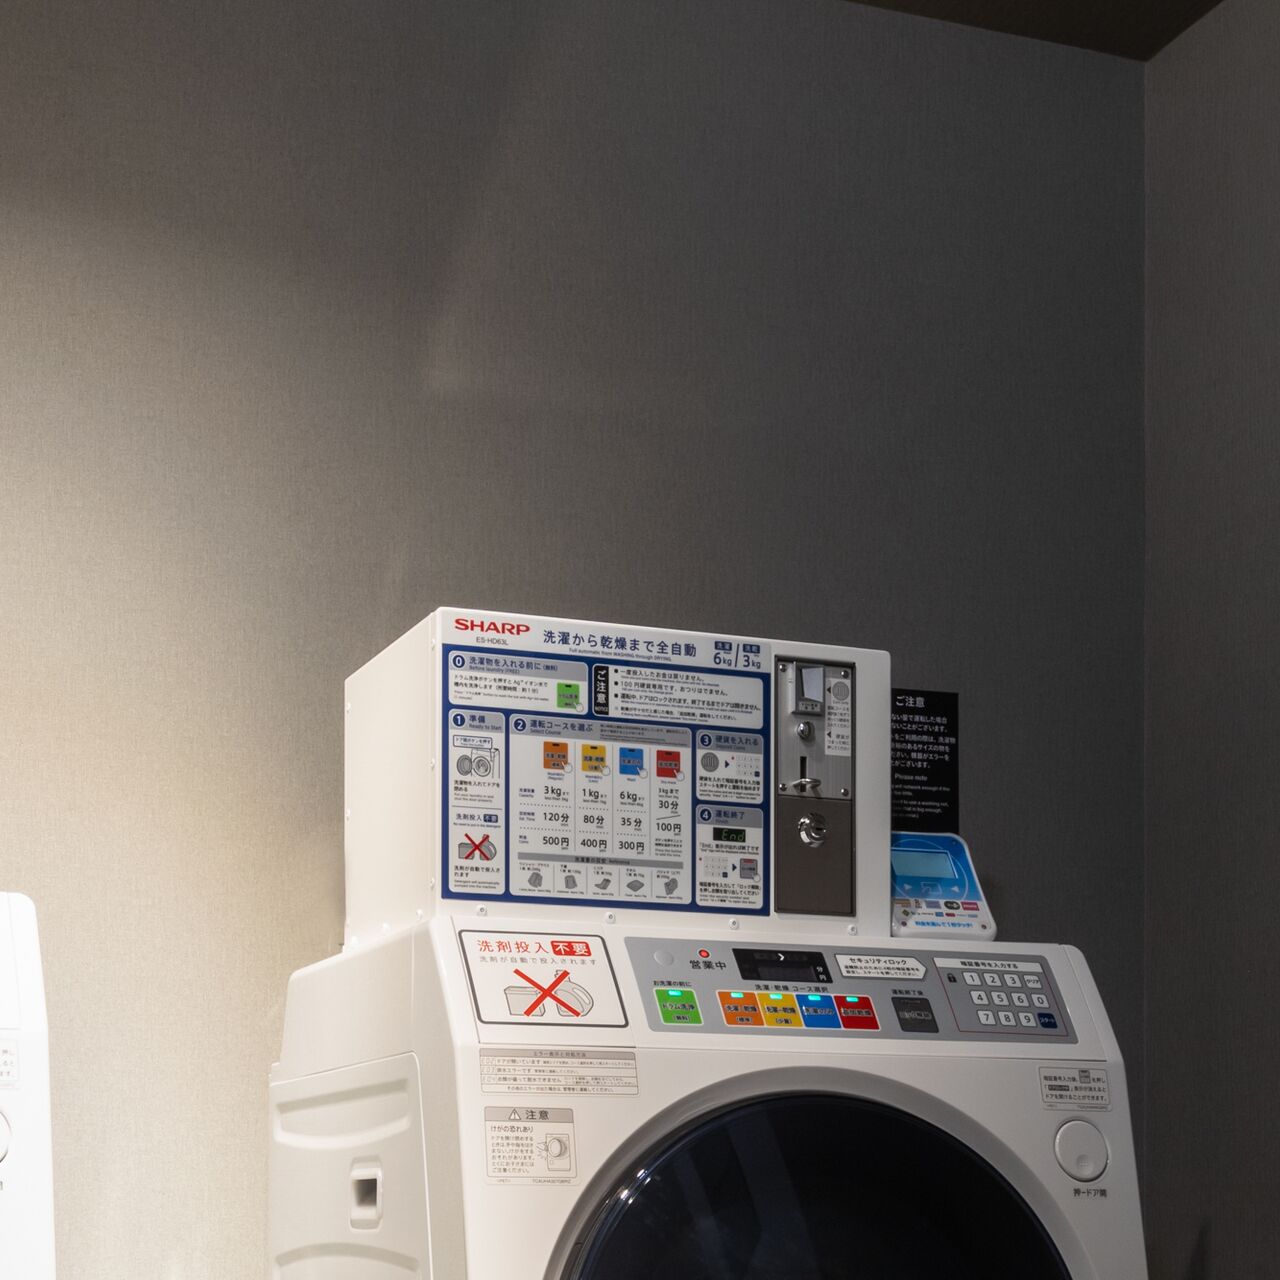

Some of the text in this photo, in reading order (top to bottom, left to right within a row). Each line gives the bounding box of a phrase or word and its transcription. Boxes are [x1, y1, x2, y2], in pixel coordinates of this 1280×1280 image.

[454, 618, 530, 636] SHARP
[543, 629, 697, 657] 洗濯から乾燥まで全自動
[530, 719, 594, 733] 運転コースを選ぶ
[721, 828, 745, 842] End
[477, 939, 590, 956] 洗剤投入 不要
[479, 956, 597, 966] 洗剤が自動で投入されます
[689, 959, 727, 971] 営業中
[849, 957, 907, 966] セキュリティロック
[960, 960, 1018, 970] 暗証番号を入力する
[969, 974, 975, 983] 1
[989, 975, 997, 984] 2
[1009, 976, 1017, 985] 3
[653, 980, 692, 988] お洗濯の前に
[976, 993, 984, 1002] 4
[997, 994, 1004, 1003] 5
[1017, 995, 1024, 1004] 6
[1037, 996, 1045, 1005] 0
[983, 1013, 990, 1022] 7
[1004, 1014, 1011, 1023] 8
[1024, 1015, 1031, 1024] 9
[525, 1109, 549, 1121] 注意
[490, 1125, 534, 1133] けがの恐れあり
